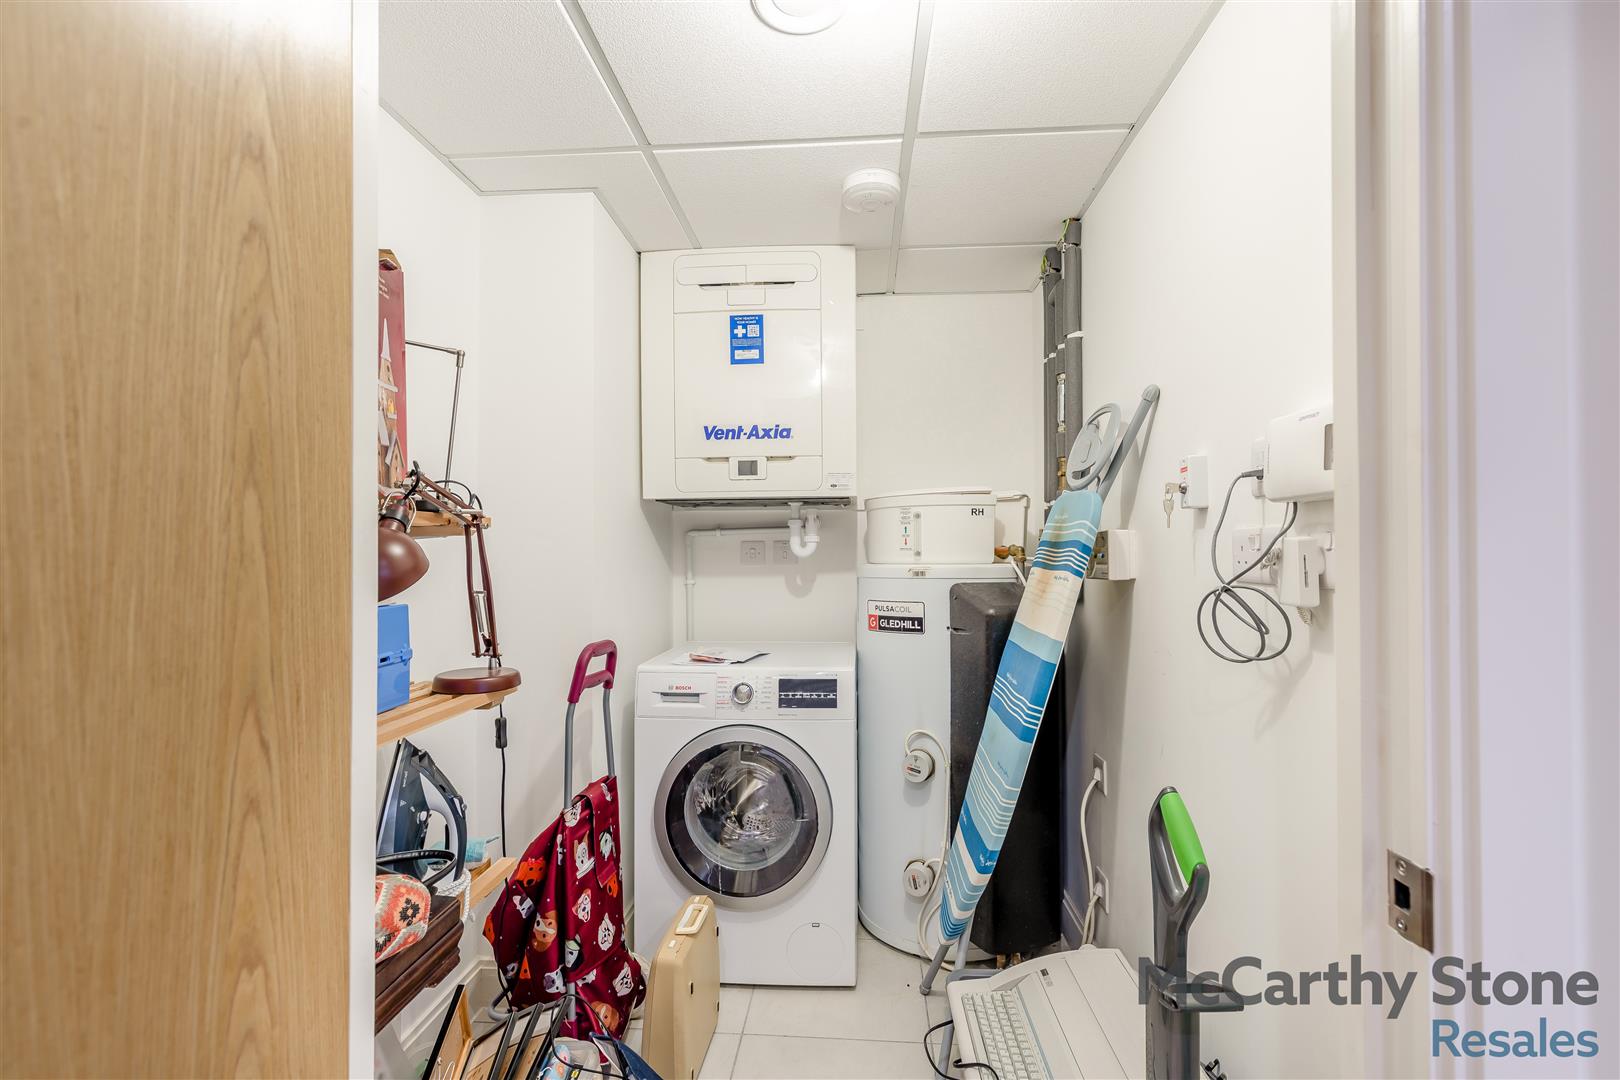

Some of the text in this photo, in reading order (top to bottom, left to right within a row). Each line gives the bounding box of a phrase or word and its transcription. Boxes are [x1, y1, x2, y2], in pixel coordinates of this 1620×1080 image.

[703, 424, 792, 441] Vent-Axia
[971, 508, 985, 516] RH
[875, 605, 913, 613] PULSACOIL
[880, 619, 922, 630] GLEDHILL
